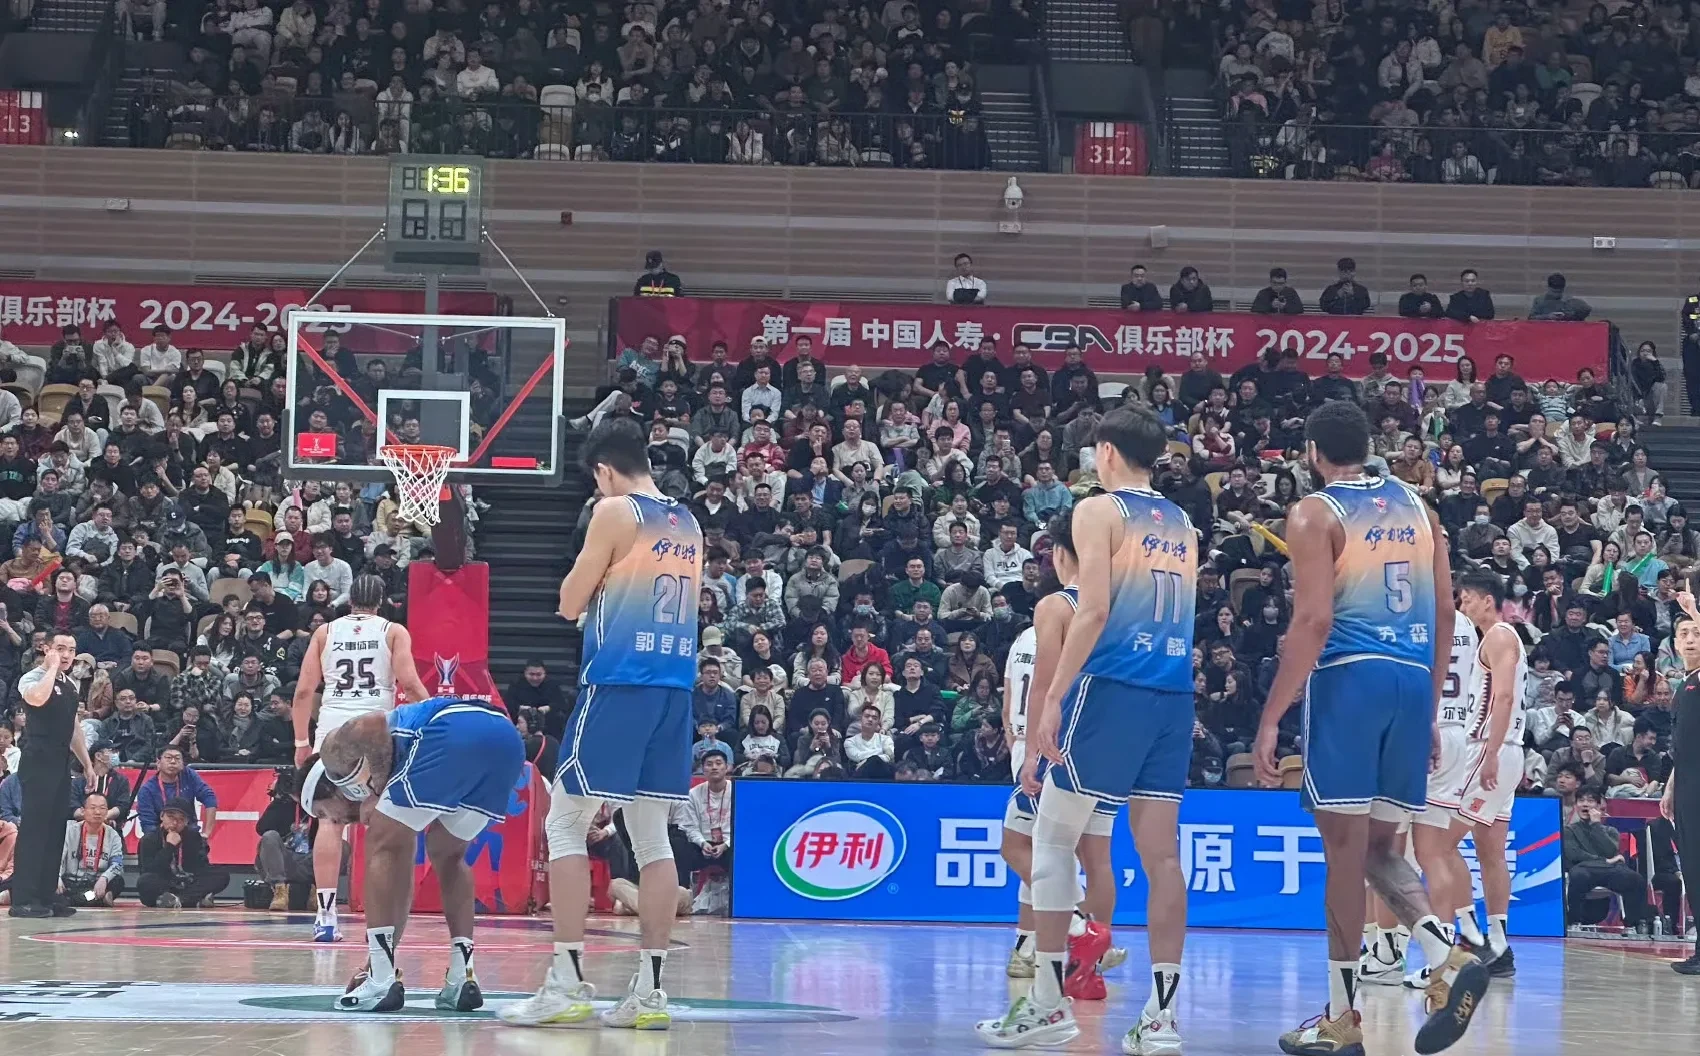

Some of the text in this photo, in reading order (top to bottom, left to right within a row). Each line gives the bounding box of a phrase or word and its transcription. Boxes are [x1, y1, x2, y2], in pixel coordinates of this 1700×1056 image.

[1089, 144, 1132, 165] 312
[427, 166, 470, 193] 1:36
[760, 314, 851, 347] 第一届
[1012, 323, 1115, 353] CBA
[1114, 324, 1235, 358] 俱乐部杯
[1256, 328, 1466, 364] 2024-2025
[652, 537, 697, 565] 伊力特
[1142, 533, 1187, 563] 伊力特
[1365, 525, 1417, 551] 伊力特
[652, 573, 691, 625] 21
[1151, 569, 1182, 624] 11
[1384, 561, 1413, 614] 5
[336, 656, 376, 691] 35
[793, 830, 885, 870] 伊利
